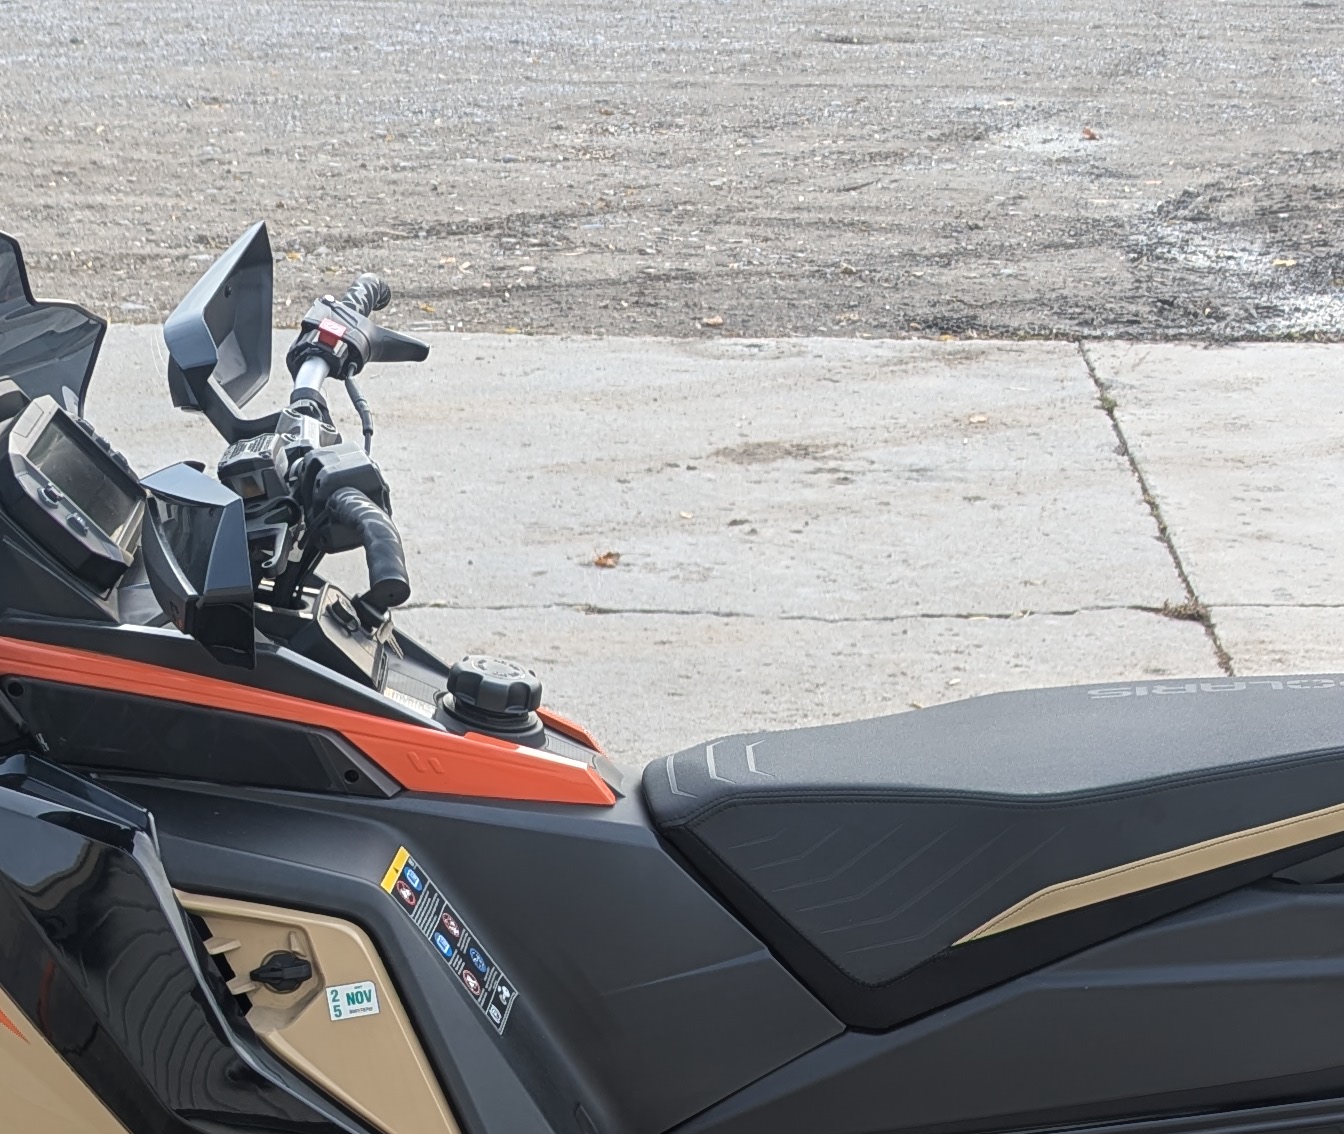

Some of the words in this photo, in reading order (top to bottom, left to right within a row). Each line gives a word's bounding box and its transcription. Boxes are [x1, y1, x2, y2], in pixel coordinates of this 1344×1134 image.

[330, 989, 340, 1003] 2
[346, 989, 372, 1006] NOV
[333, 1004, 343, 1018] 5
